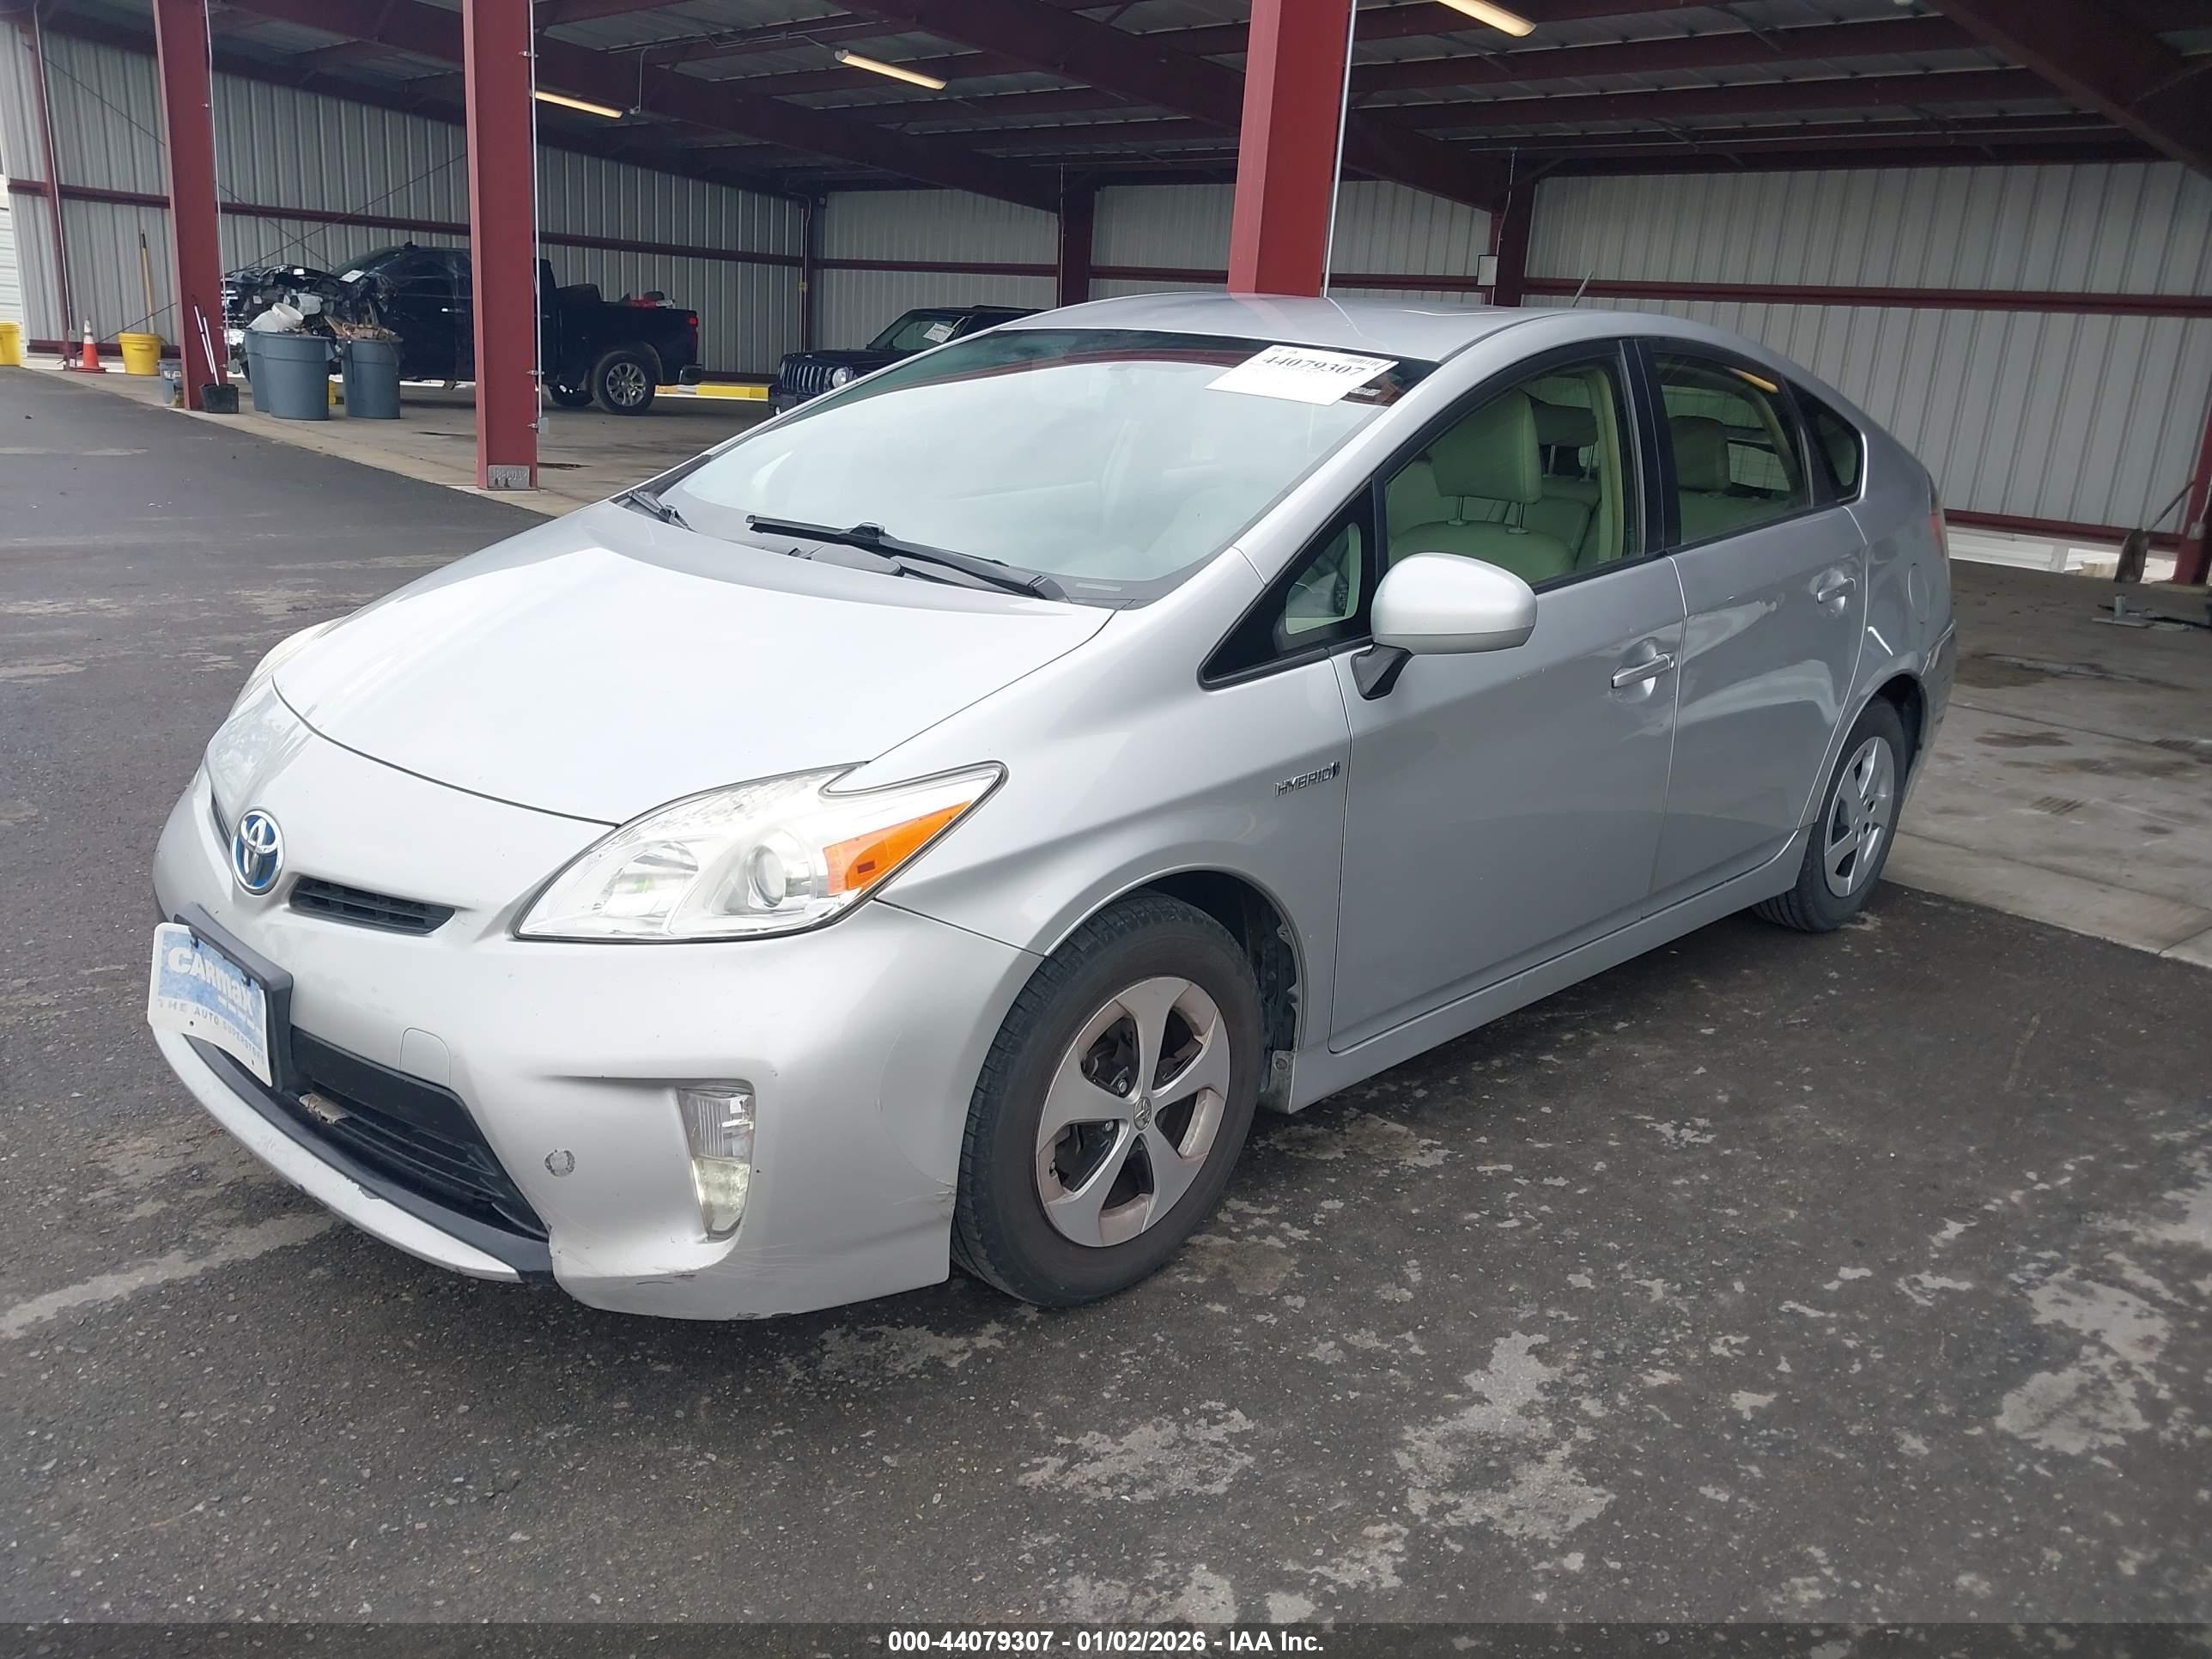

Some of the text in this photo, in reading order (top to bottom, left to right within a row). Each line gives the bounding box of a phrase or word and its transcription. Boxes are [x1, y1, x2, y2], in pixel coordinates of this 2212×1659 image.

[1263, 356, 1367, 376] 44079307
[1273, 767, 1333, 797] HYBRID
[158, 999, 186, 1012] THE
[194, 1007, 219, 1024] AUTO
